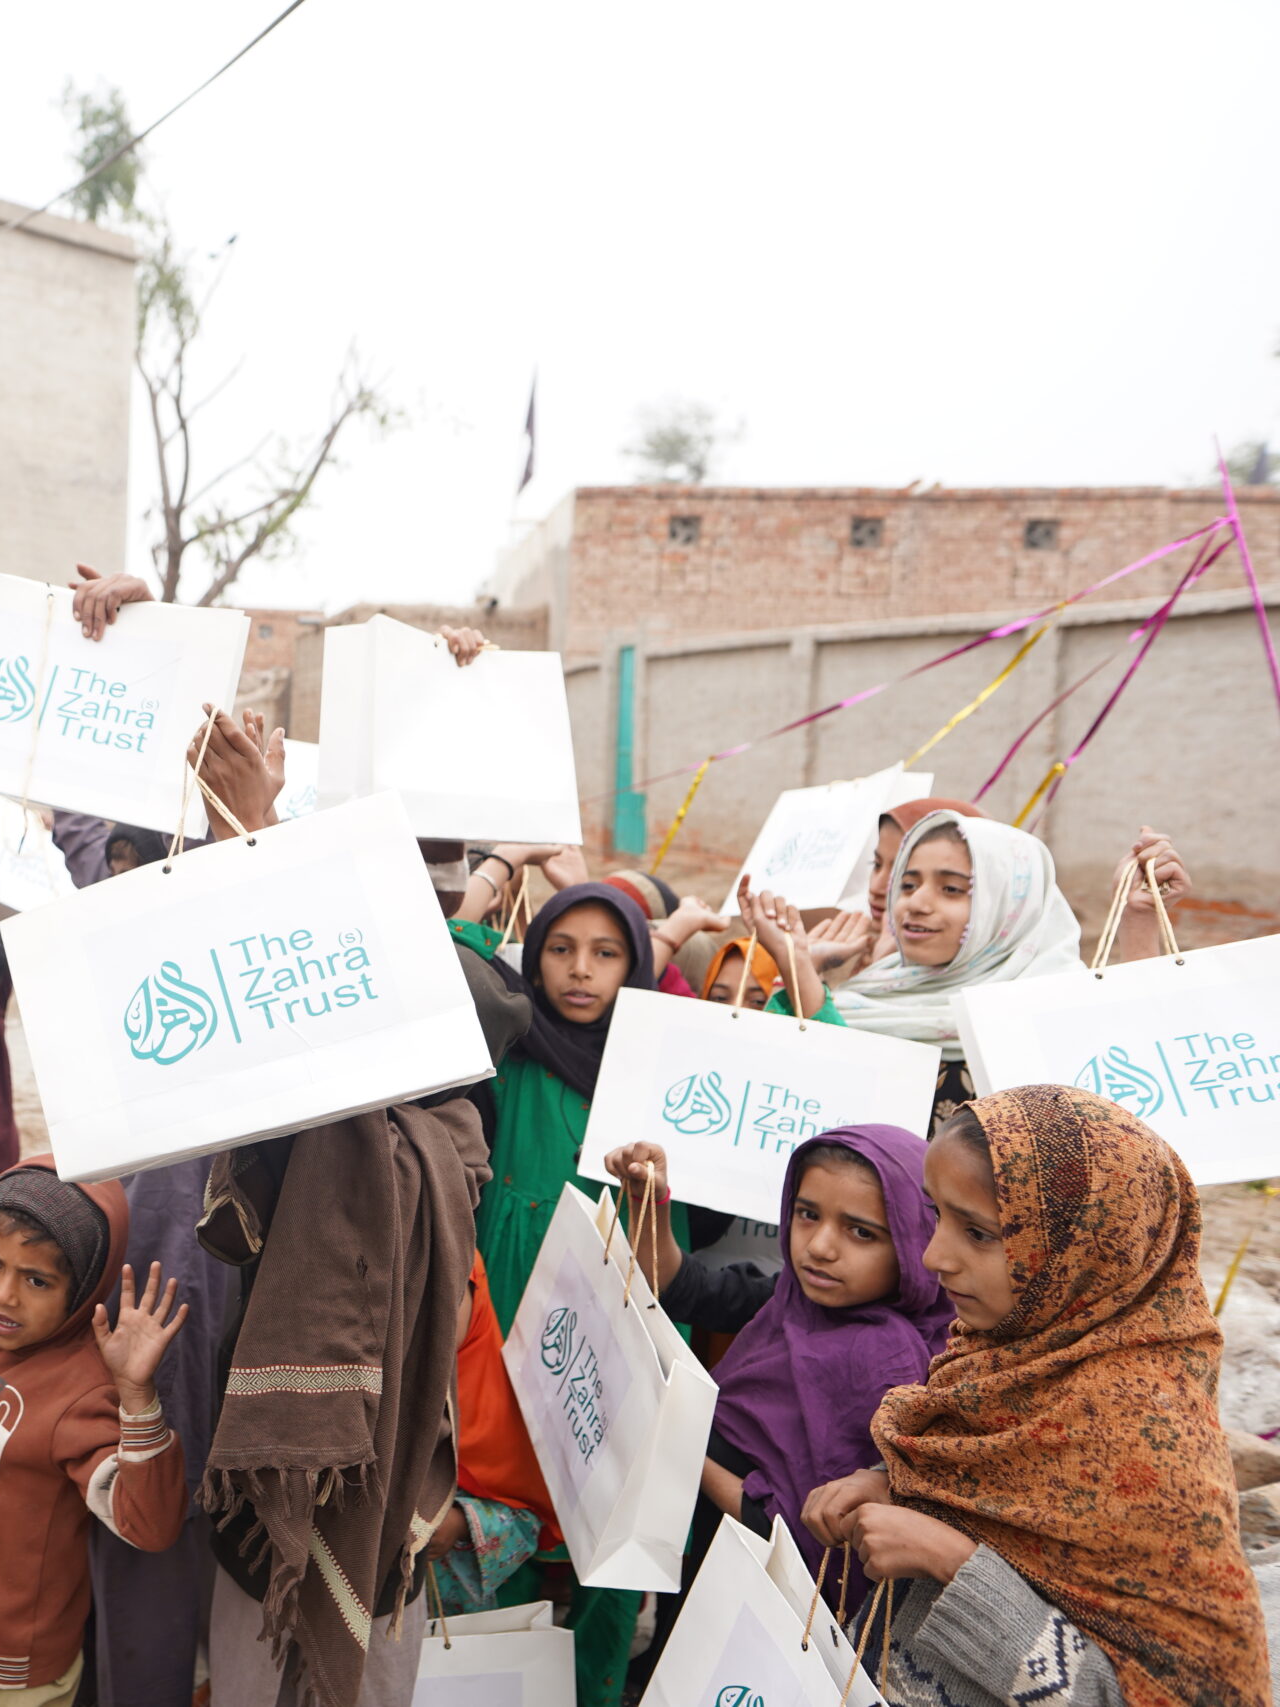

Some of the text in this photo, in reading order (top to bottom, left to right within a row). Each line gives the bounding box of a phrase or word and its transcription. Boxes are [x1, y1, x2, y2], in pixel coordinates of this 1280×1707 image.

[71, 667, 127, 698] The
[58, 690, 155, 729] Zahra
[57, 713, 148, 753] Trust
[229, 928, 314, 966] The
[239, 946, 372, 1003] Zahra
[248, 973, 379, 1030] Trust
[1174, 1032, 1255, 1057] The
[1184, 1053, 1280, 1085] Zahr
[762, 1083, 821, 1115] The
[1194, 1083, 1280, 1109] Tru
[584, 1345, 603, 1399] The
[563, 1385, 595, 1466] Trust
[570, 1366, 605, 1447] Zahra
